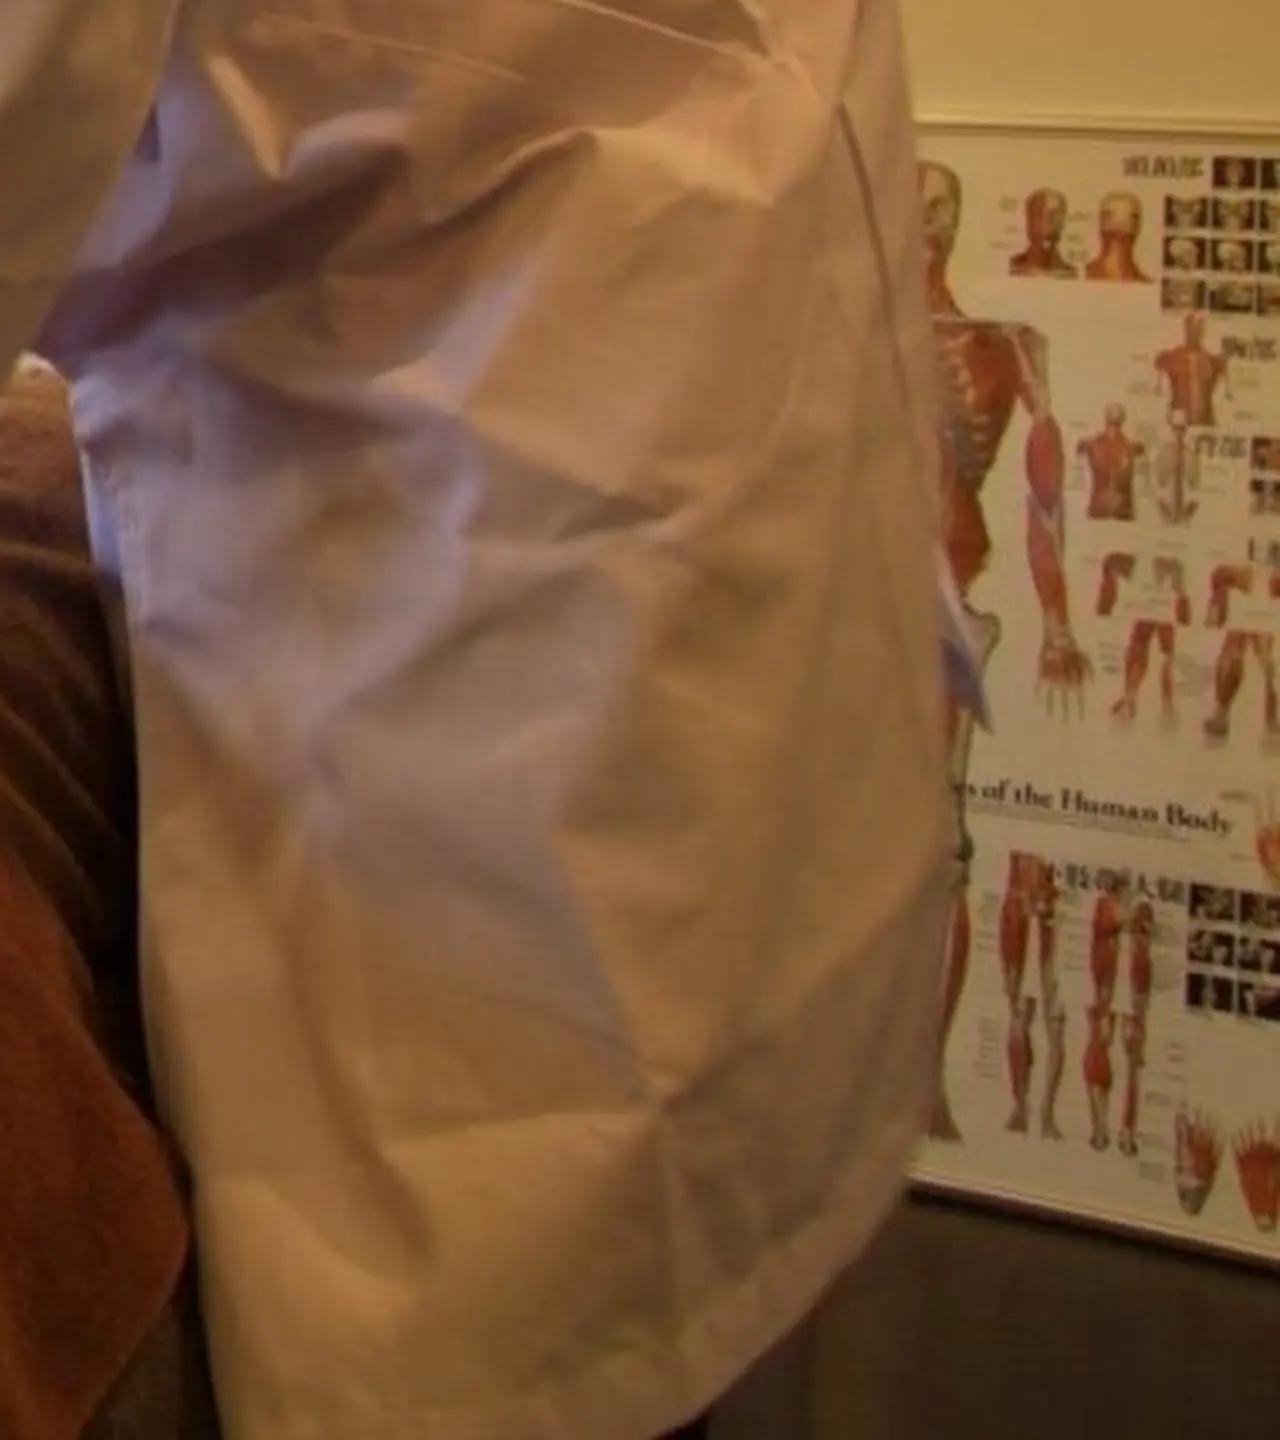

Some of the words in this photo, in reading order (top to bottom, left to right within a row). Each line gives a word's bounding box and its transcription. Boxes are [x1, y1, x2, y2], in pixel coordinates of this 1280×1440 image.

[981, 778, 1012, 802] of
[1014, 782, 1054, 810] the
[1061, 788, 1159, 823] Human
[1165, 803, 1233, 835] Body
